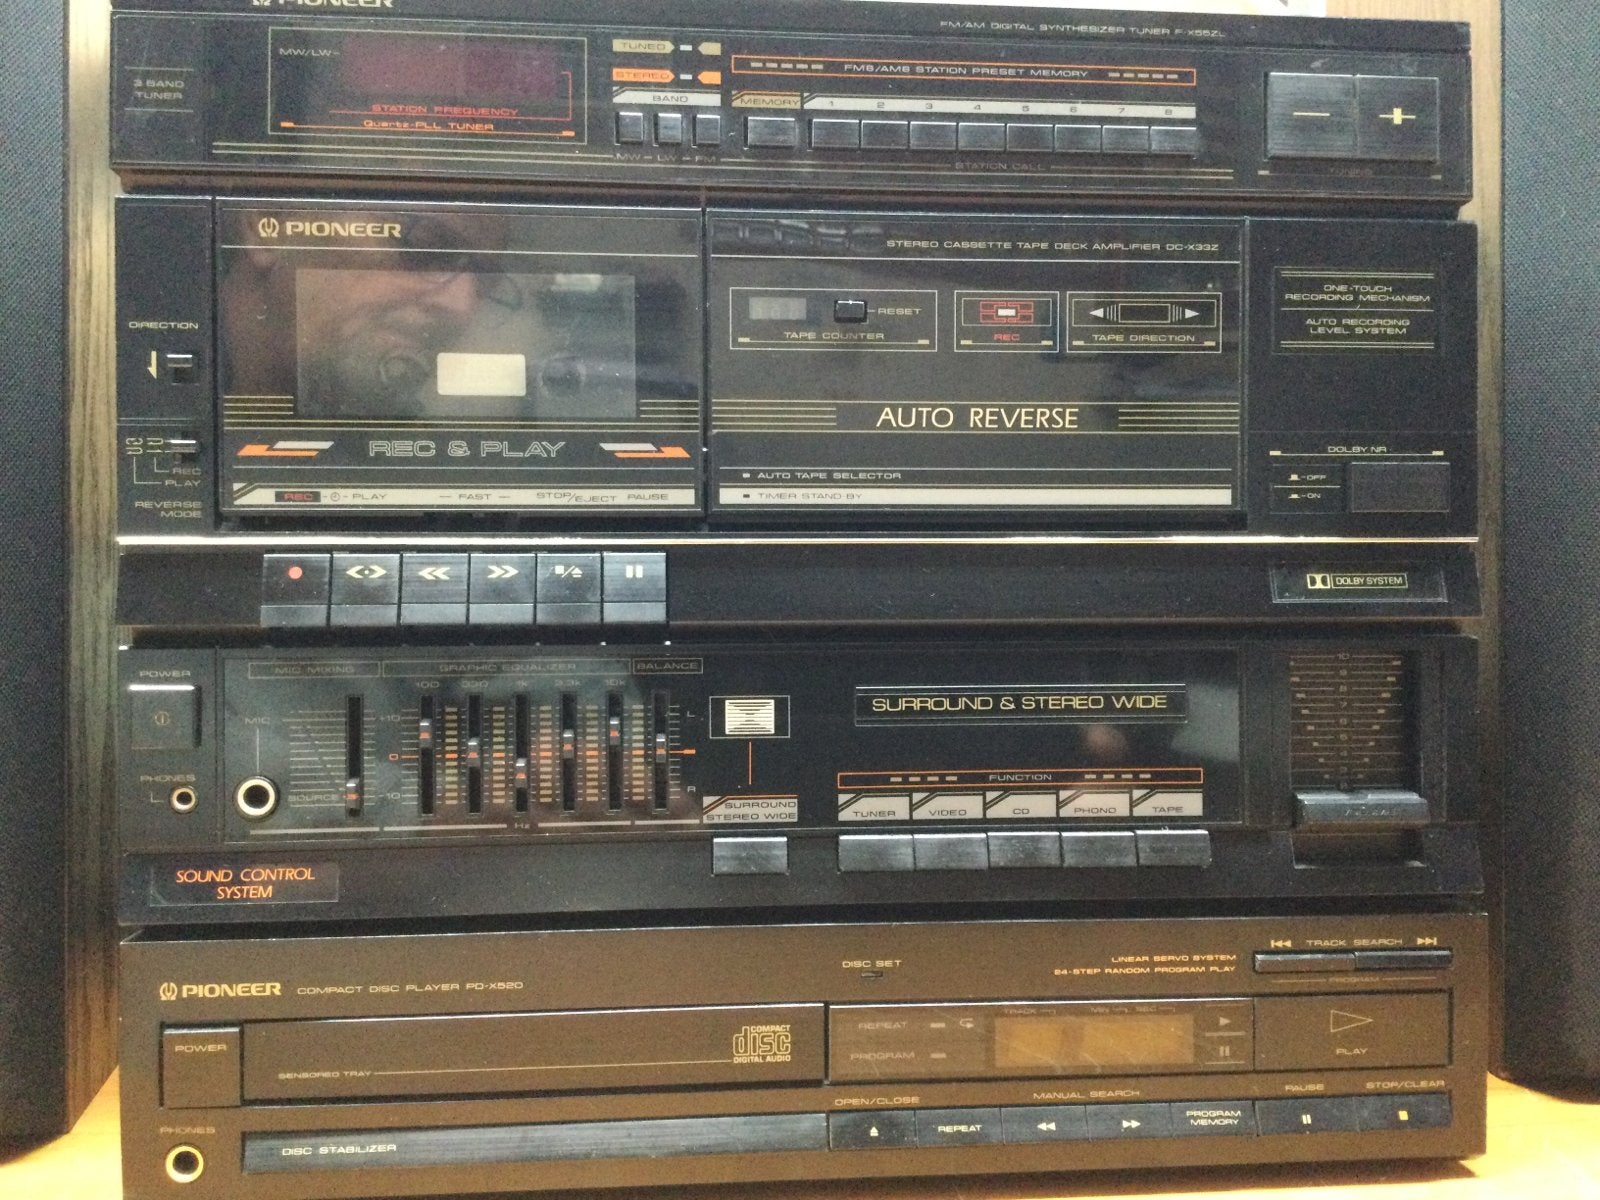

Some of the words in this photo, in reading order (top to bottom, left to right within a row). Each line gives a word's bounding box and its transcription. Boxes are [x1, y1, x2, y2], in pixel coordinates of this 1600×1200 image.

[940, 21, 985, 30] FM/AM
[991, 23, 1034, 31] DIGITAL
[1039, 24, 1125, 33] SYNTHESIZER
[1129, 27, 1170, 35] TUNER
[620, 42, 666, 50] TUNED
[845, 64, 910, 73] FM8/AM8
[916, 66, 967, 75] STATION
[972, 67, 1024, 76] PRESET
[1030, 69, 1088, 78] MEMORY
[616, 72, 670, 81] STEREO
[146, 80, 185, 88] BAND
[135, 91, 183, 100] TUNER
[652, 95, 688, 103] BAND
[740, 98, 800, 107] MEMORY
[372, 104, 427, 114] STATION
[434, 105, 518, 116] FREQUENCY
[448, 122, 493, 131] TUNER
[955, 162, 1007, 170] STATION
[1012, 162, 1044, 170] CALL
[286, 222, 401, 237] PIONEER
[887, 240, 939, 248] STEREO
[944, 241, 1012, 249] CASSETTE
[1324, 284, 1392, 292] ONE-TOUCH
[1359, 294, 1430, 302] MECHANISM
[129, 321, 198, 329] DIRECTION
[784, 331, 816, 340] TAPE
[822, 332, 884, 340] COUNTER
[876, 407, 953, 428] AUTO
[969, 408, 1079, 429] REVERSE
[369, 441, 436, 457] REC
[448, 441, 470, 457] &
[481, 441, 566, 457] PLAY
[758, 472, 791, 480] AUTO
[795, 472, 828, 480] TAPE
[833, 472, 901, 480] SELECTOR
[284, 493, 313, 501] REC
[352, 493, 386, 501] PLAY
[536, 492, 617, 503] STOP/EJECT
[161, 510, 202, 518] MODE
[1336, 576, 1365, 585] DOLBY
[1367, 576, 1403, 586] SYSTEM
[275, 666, 300, 674] MIC
[307, 666, 354, 674] MIXING
[439, 664, 497, 672] GRAPHIC
[502, 663, 576, 671] EQUALIZER
[637, 662, 698, 670] BALANCE
[872, 696, 993, 712] SURROUND
[1000, 697, 1016, 710] &
[1021, 696, 1103, 710] STEREO
[1111, 694, 1167, 709] WIDE
[245, 717, 270, 725] MIC
[140, 774, 196, 783] PHONES
[989, 773, 1052, 781] FUNCTION
[288, 793, 339, 801] SOURCE
[725, 801, 796, 810] SURROUND
[706, 813, 760, 821] STEREO
[764, 812, 796, 820] WIDE
[853, 810, 896, 818] TUNER
[176, 869, 233, 884] SOUND
[240, 868, 315, 882] CONTROL
[217, 885, 273, 899] SYSTEM
[1353, 938, 1402, 946] SEARCH
[1054, 968, 1101, 976] 24-STEP
[182, 982, 281, 998] PIONEER
[297, 986, 363, 995] COMPACT
[369, 985, 400, 993] DISC
[405, 983, 459, 992] PLAYER
[859, 1022, 907, 1030] REPEAT
[733, 1026, 791, 1055] disc
[175, 1044, 227, 1052] POWER
[850, 1052, 914, 1061] PROGRAM
[278, 1071, 339, 1079] SENSORED
[1366, 1080, 1444, 1089] STOP/CLEAR
[1090, 1090, 1140, 1098] SEARCH
[834, 1097, 920, 1106] OPEN/CLOSE
[1186, 1110, 1241, 1118] PROGRAM
[160, 1126, 216, 1135] PHONES
[938, 1124, 982, 1133] REPEAT
[282, 1147, 312, 1156] DISC
[319, 1144, 396, 1155] STABILIZER
